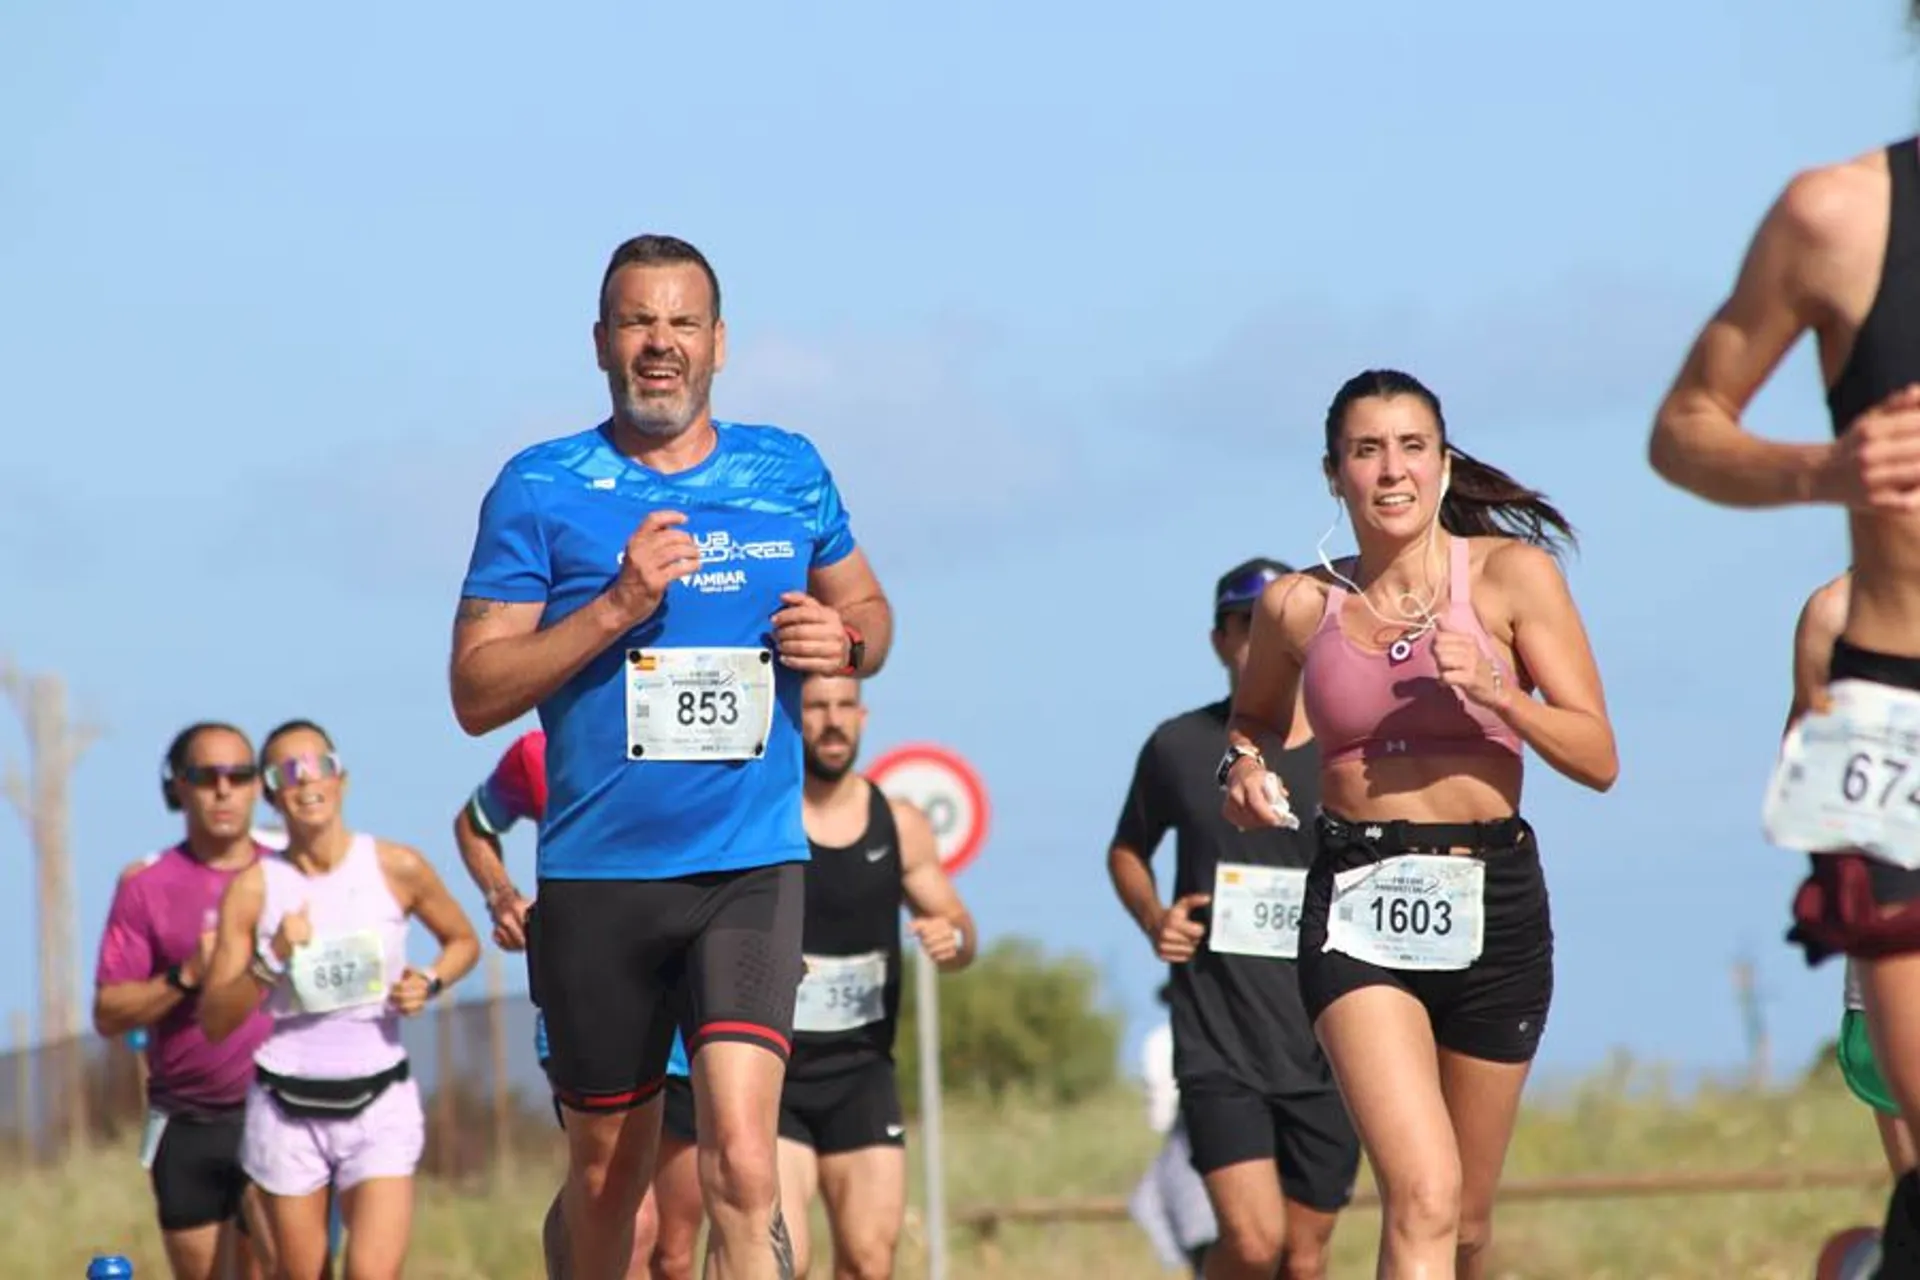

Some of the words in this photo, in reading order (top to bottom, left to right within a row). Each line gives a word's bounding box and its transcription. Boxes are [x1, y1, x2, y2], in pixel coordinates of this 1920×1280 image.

[692, 570, 748, 588] AMBAR
[676, 690, 739, 726] 853
[1371, 896, 1452, 935] 1603
[314, 962, 356, 990] 887
